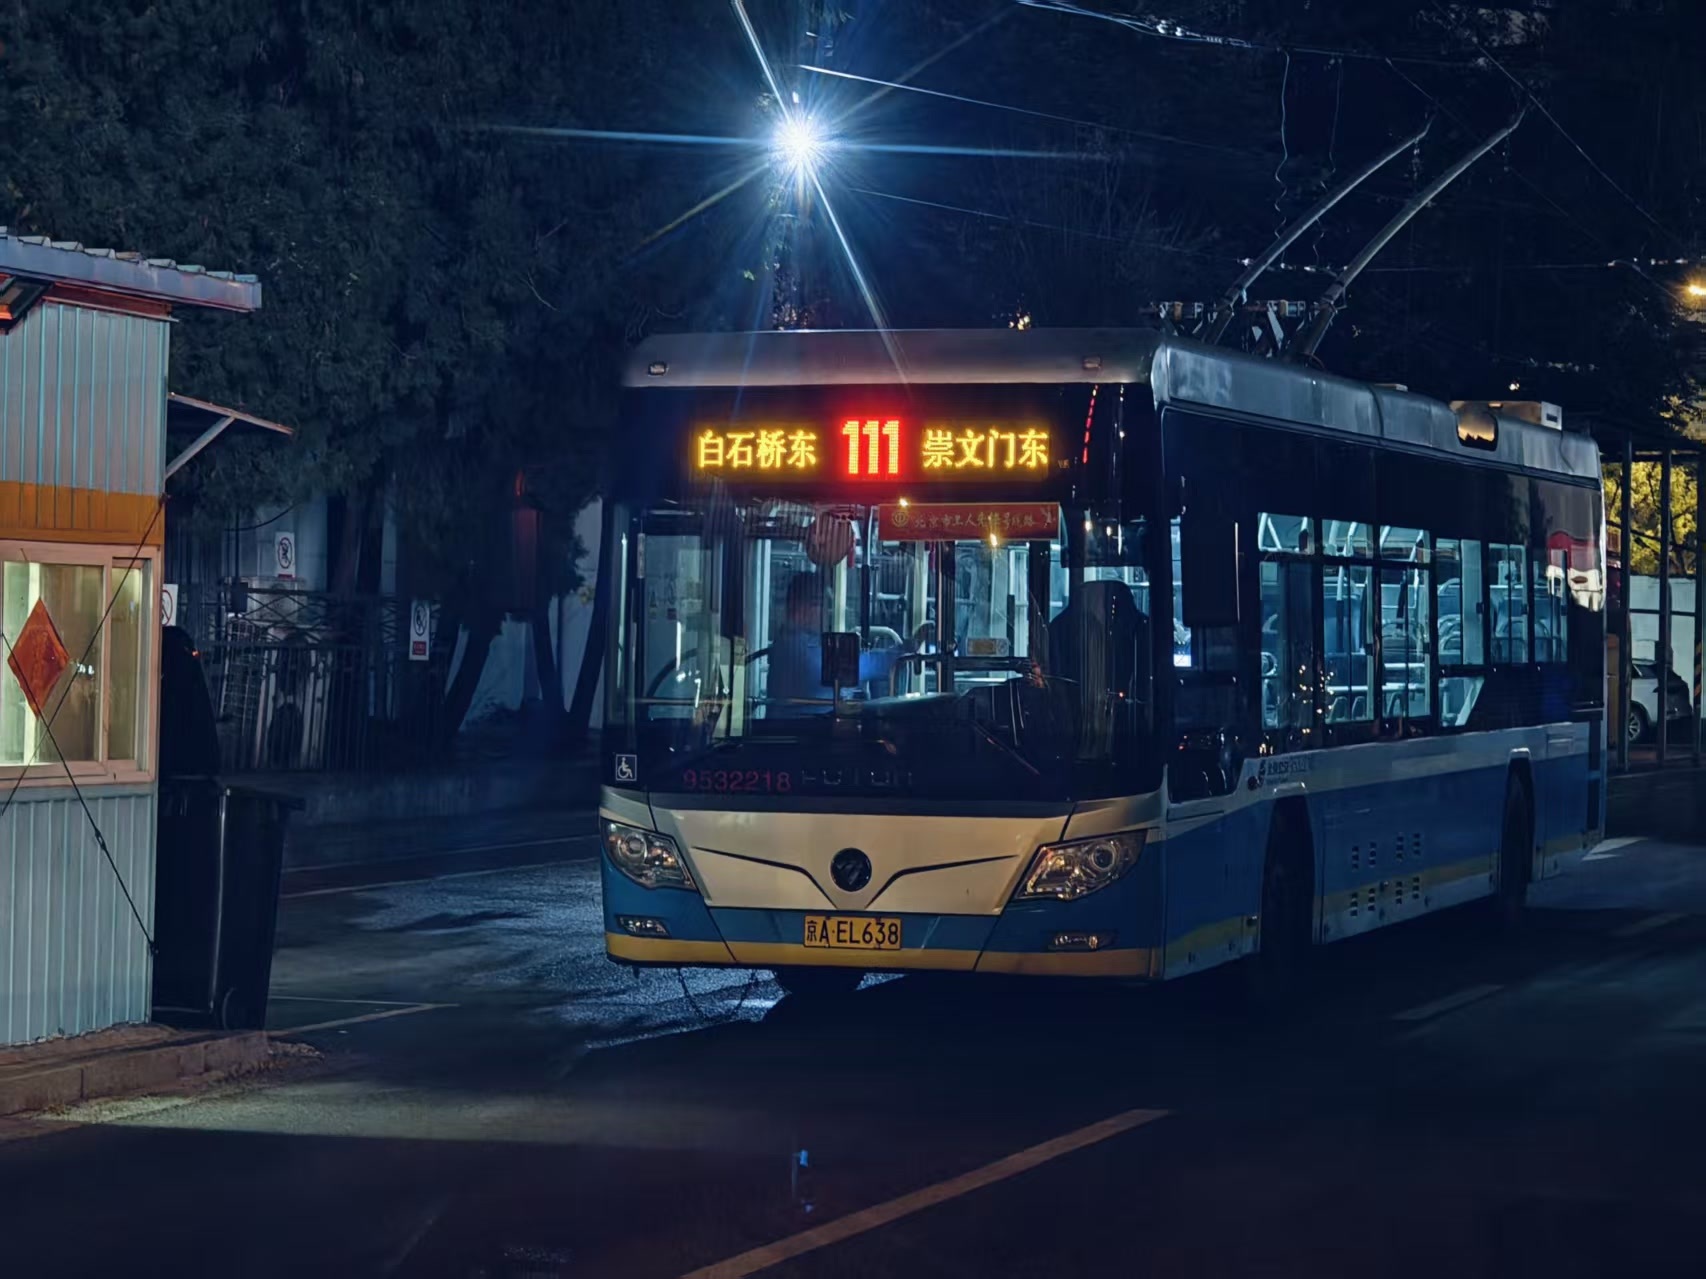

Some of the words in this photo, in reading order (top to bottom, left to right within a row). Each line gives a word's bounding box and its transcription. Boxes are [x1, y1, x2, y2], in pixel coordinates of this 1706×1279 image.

[698, 428, 817, 470] 白石桥东
[842, 420, 899, 475] 111
[922, 428, 1049, 470] 崇文门东
[682, 768, 792, 793] 9532218
